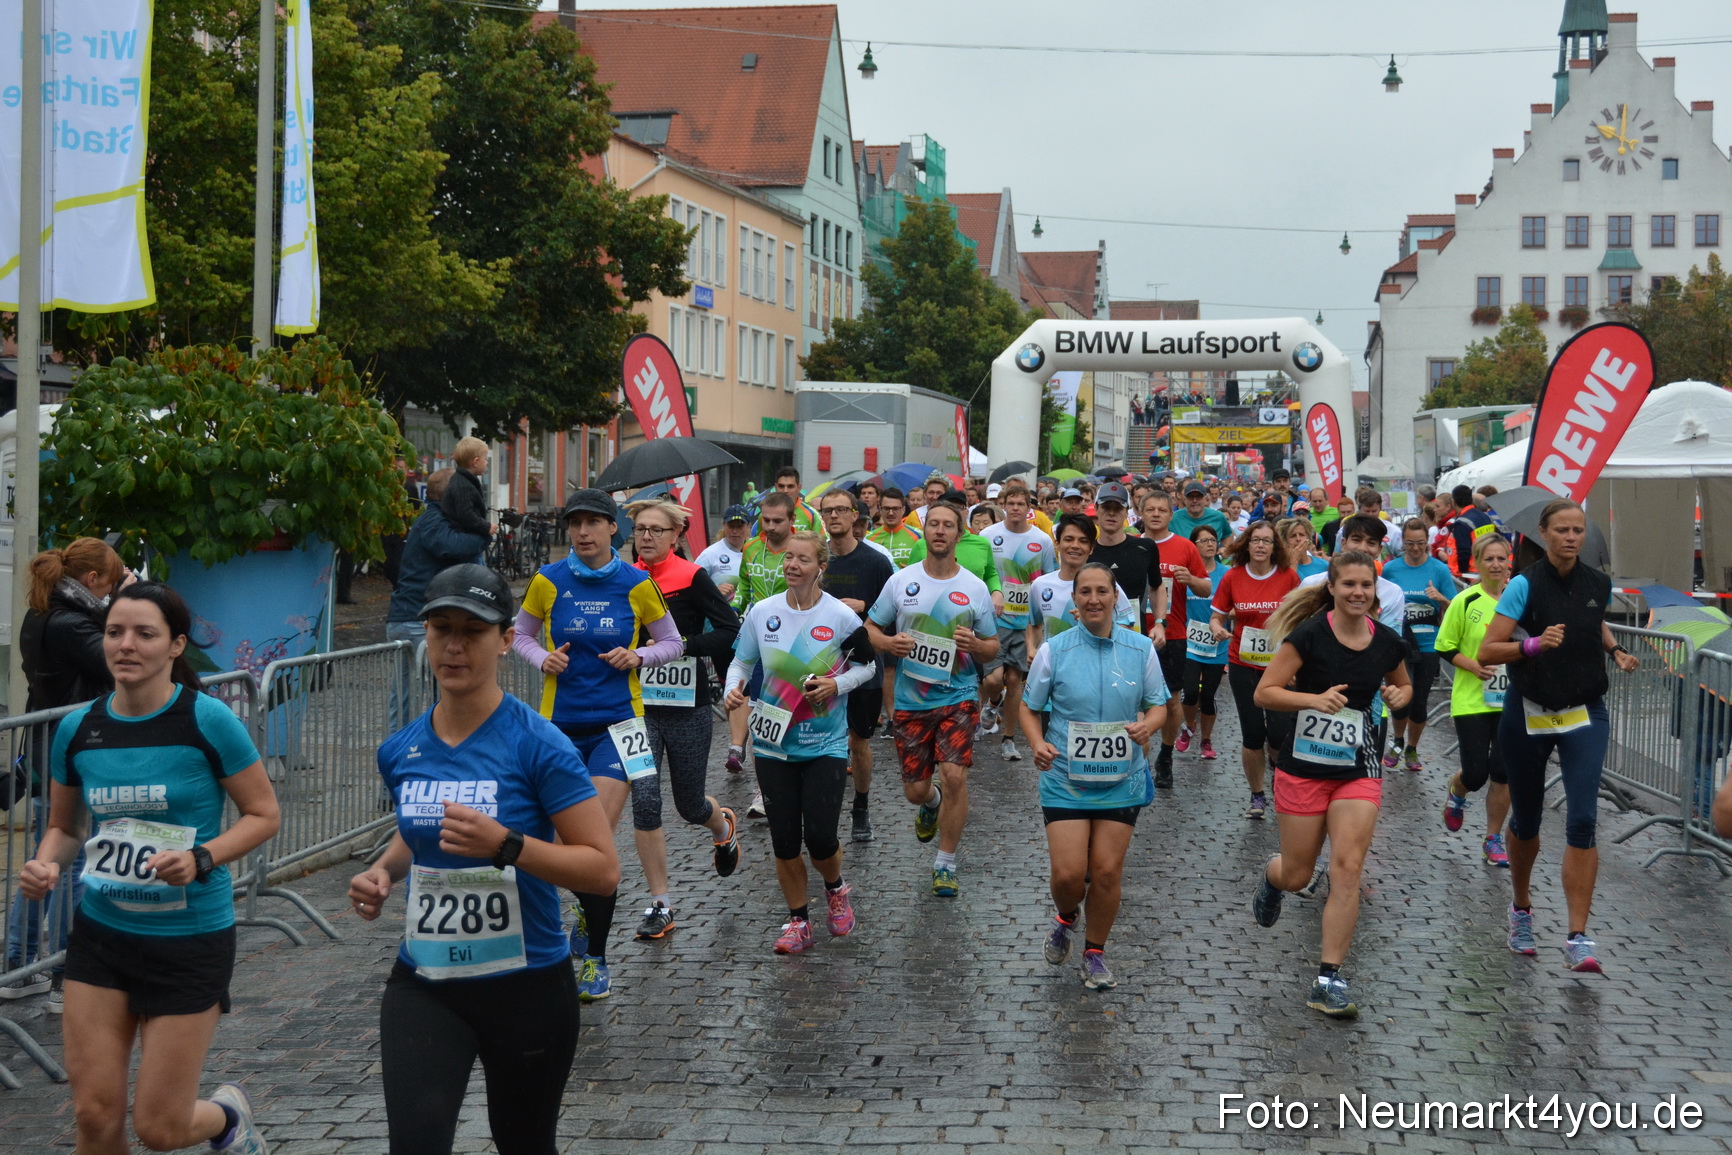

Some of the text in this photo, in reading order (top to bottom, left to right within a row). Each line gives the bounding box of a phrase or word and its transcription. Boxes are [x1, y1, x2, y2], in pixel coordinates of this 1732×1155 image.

[1055, 330, 1281, 359] BMW Laufsport
[1536, 347, 1638, 498] REWE
[1218, 430, 1245, 441] ZIEL
[1234, 601, 1278, 611] NEUMARKT
[600, 617, 614, 628] FR
[645, 666, 692, 686] 2600
[656, 689, 676, 699] Petra
[799, 722, 814, 732] 17.
[1551, 717, 1564, 726] Evi
[1302, 715, 1357, 746] 2733
[1074, 736, 1127, 759] 2739
[1309, 743, 1344, 758] Melanie
[1083, 764, 1118, 773] Melanie
[89, 784, 167, 805] HUBER
[401, 780, 498, 804] HUBER
[104, 802, 165, 812] TECHNOLOGY
[412, 818, 437, 826] WASTE
[133, 822, 187, 843] BOCK
[95, 839, 158, 880] 206
[101, 882, 161, 901] Christina
[417, 892, 510, 935] 2289
[449, 946, 472, 962] Evi
